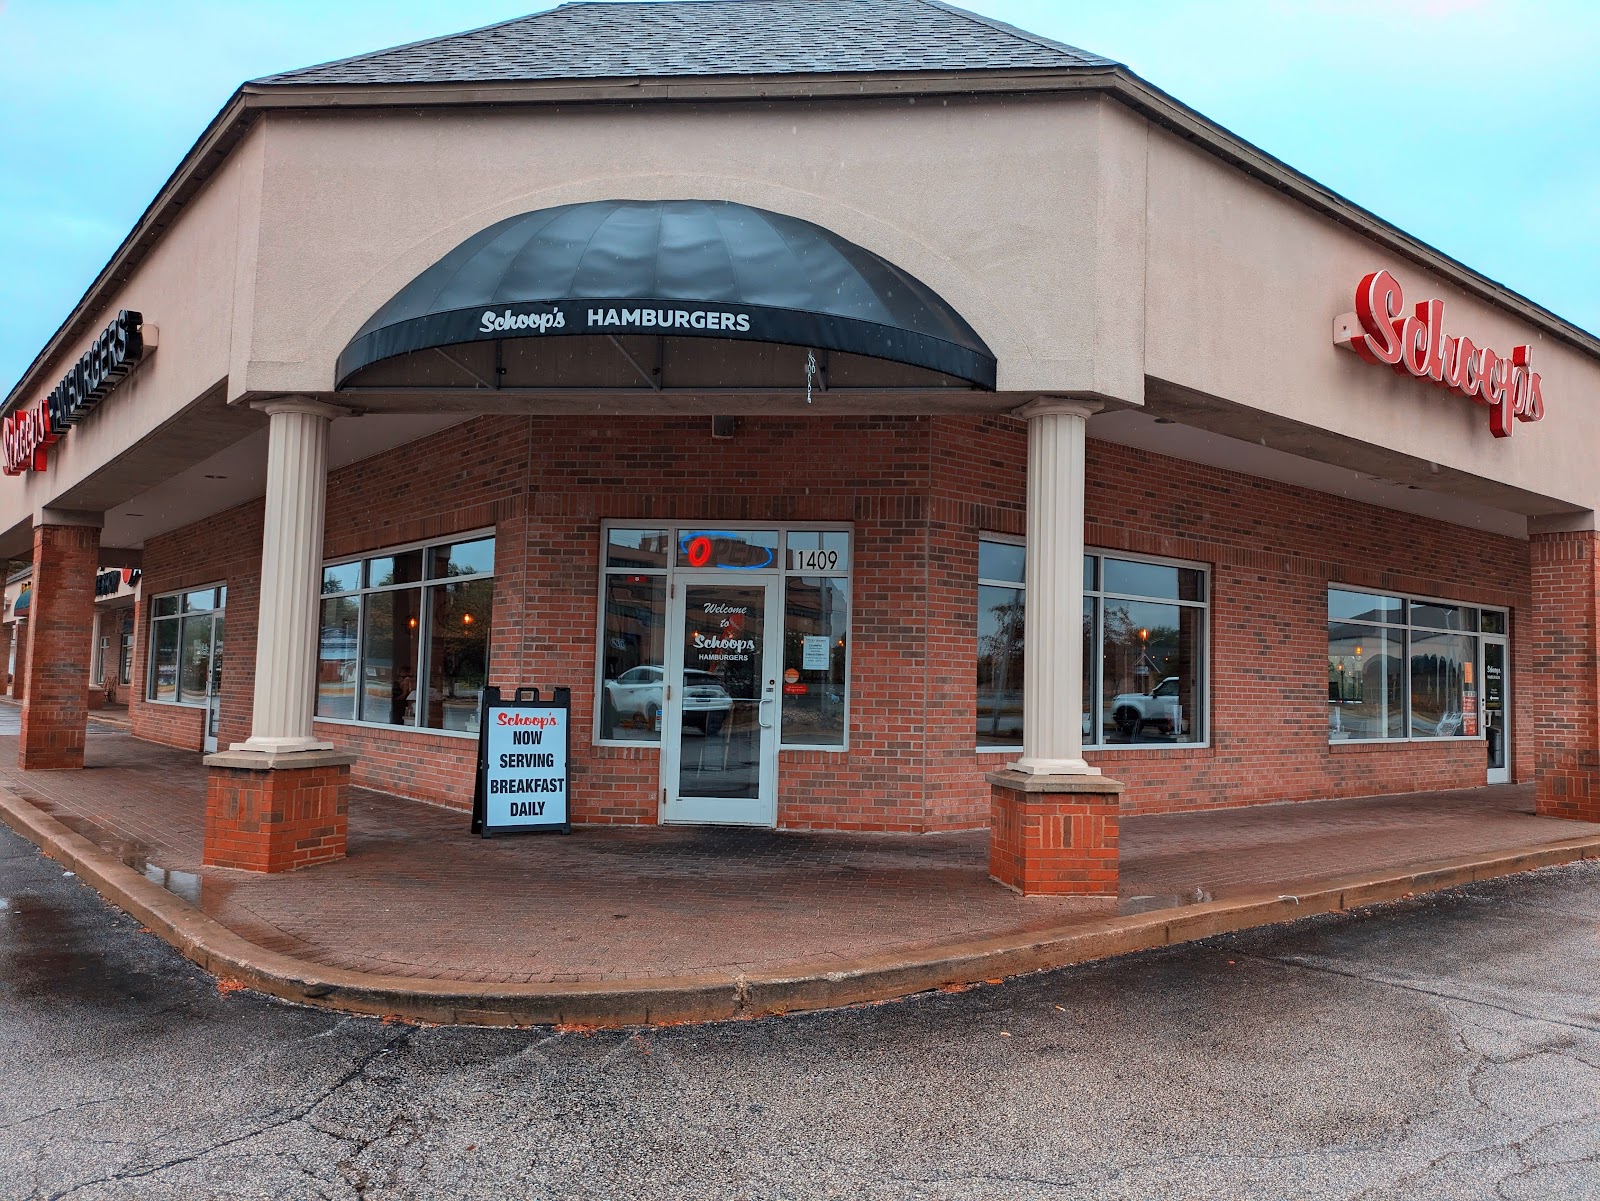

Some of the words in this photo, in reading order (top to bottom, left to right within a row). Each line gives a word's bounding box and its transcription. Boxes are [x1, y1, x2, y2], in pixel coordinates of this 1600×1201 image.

[479, 307, 566, 334] Schoop's
[587, 308, 751, 332] HAMBURGERS
[1350, 269, 1545, 438] Schoop's
[47, 309, 142, 434] HAMBURGERS
[798, 550, 838, 570] 1409
[703, 602, 747, 614] Welcome
[719, 618, 730, 628] to
[698, 653, 749, 662] HAMBURGERS
[497, 712, 557, 729] Schoop's
[513, 731, 542, 745] NOW
[500, 753, 554, 768] SERVING
[491, 778, 564, 794] BREAKFAST
[510, 802, 545, 816] DAILY
